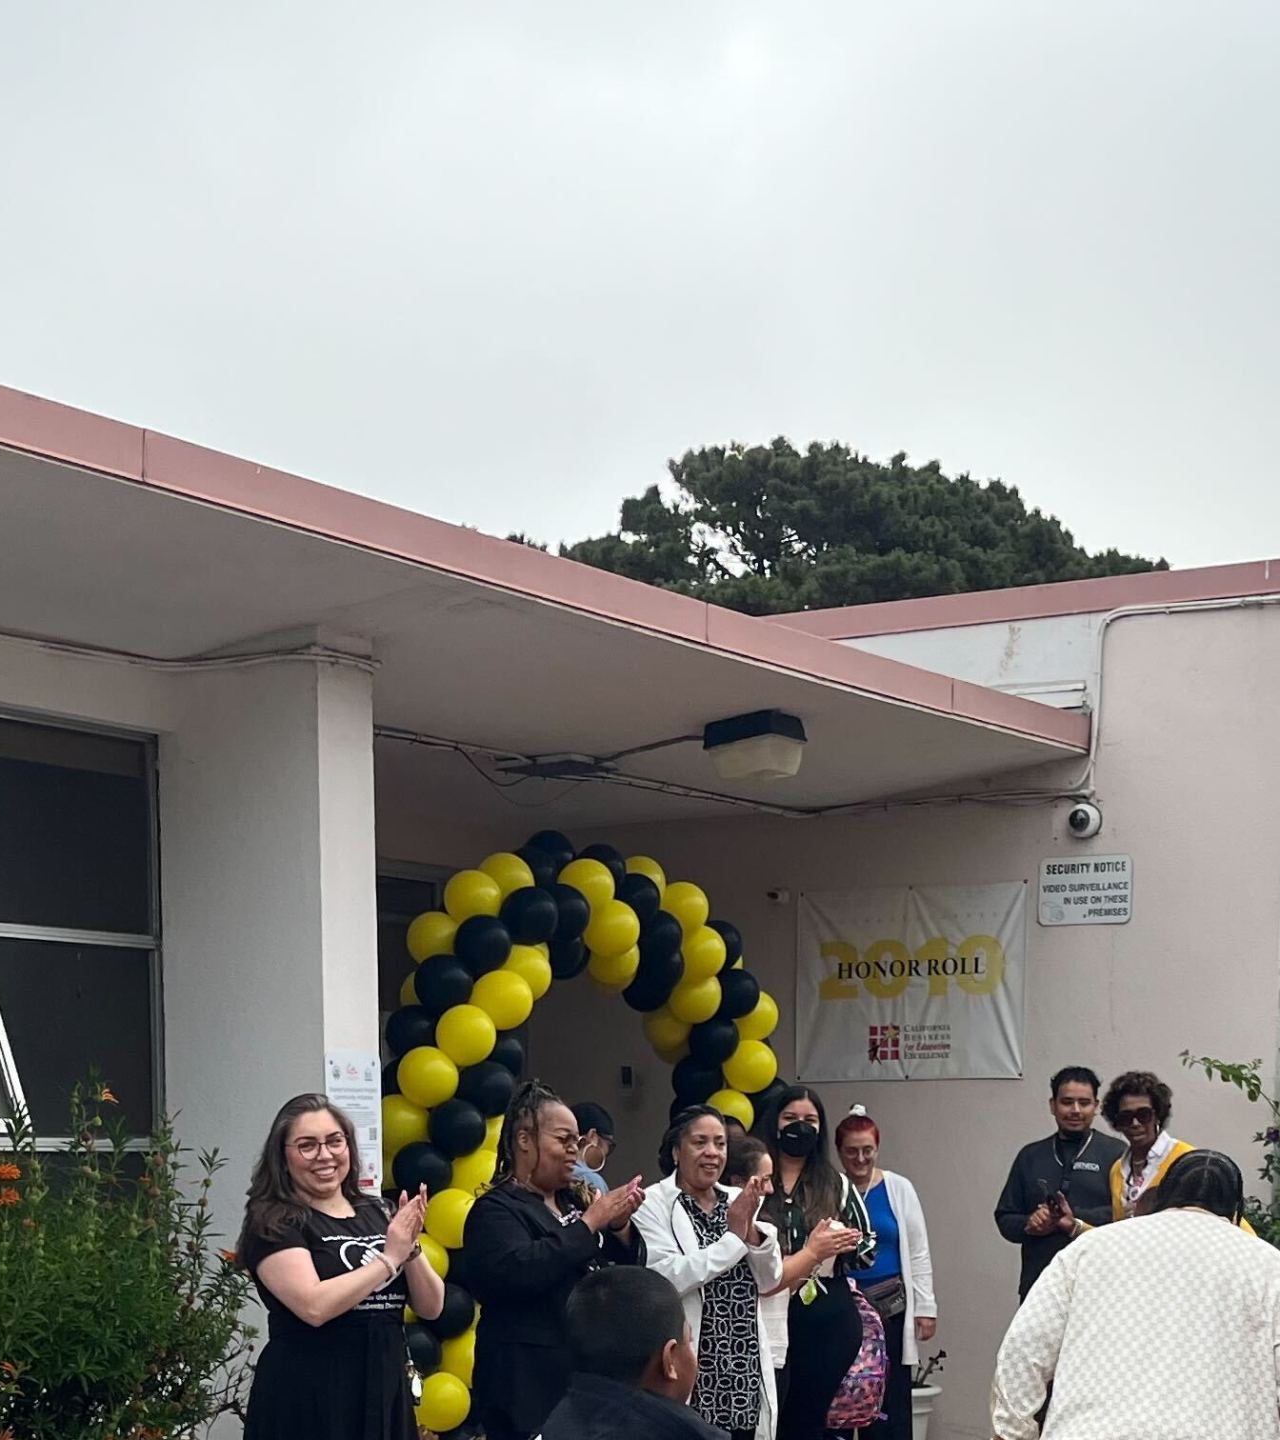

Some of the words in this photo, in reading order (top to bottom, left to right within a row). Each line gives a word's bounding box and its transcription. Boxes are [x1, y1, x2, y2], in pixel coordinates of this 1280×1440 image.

[1046, 863, 1091, 875] SECURITY
[1093, 861, 1127, 873] NOTICE
[1042, 884, 1067, 893] VIDEO
[1068, 881, 1129, 892] SURVEILLANCE
[1063, 897, 1072, 905] IN
[1073, 896, 1088, 905] USE
[1090, 895, 1102, 904] ON
[1103, 894, 1128, 903] THESE
[1088, 907, 1129, 917] PREMISES
[819, 934, 1004, 999] 2010
[837, 959, 922, 979] HONOR
[927, 956, 986, 976] ROLL
